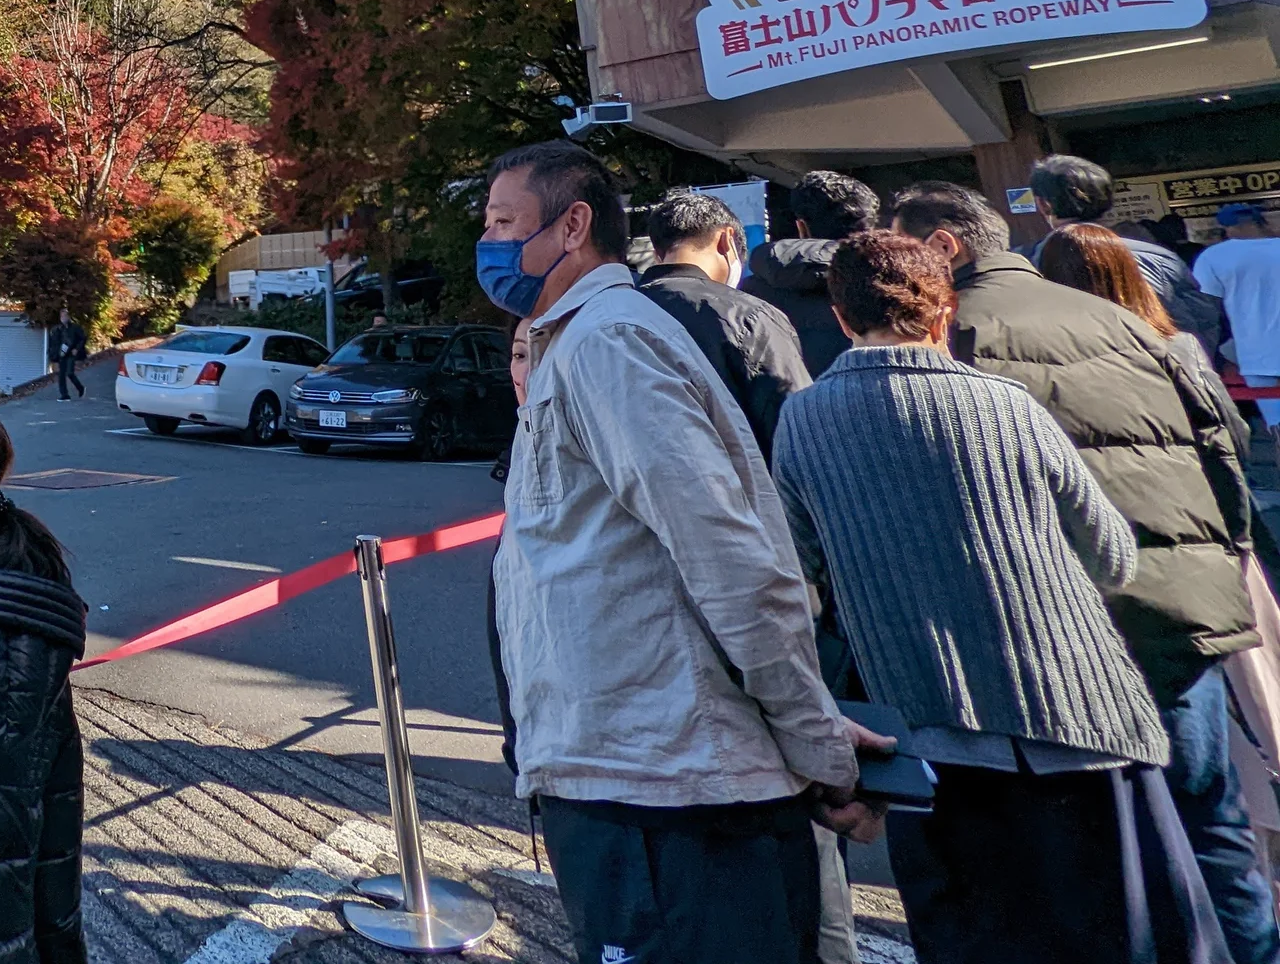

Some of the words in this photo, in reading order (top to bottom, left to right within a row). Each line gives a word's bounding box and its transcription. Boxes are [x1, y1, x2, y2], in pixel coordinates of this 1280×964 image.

[852, 13, 988, 50] PANORAMIC
[1170, 175, 1244, 199] 営業中
[1246, 171, 1280, 191] OP
[325, 417, 345, 426] 61-22
[604, 944, 625, 960] NIKE
